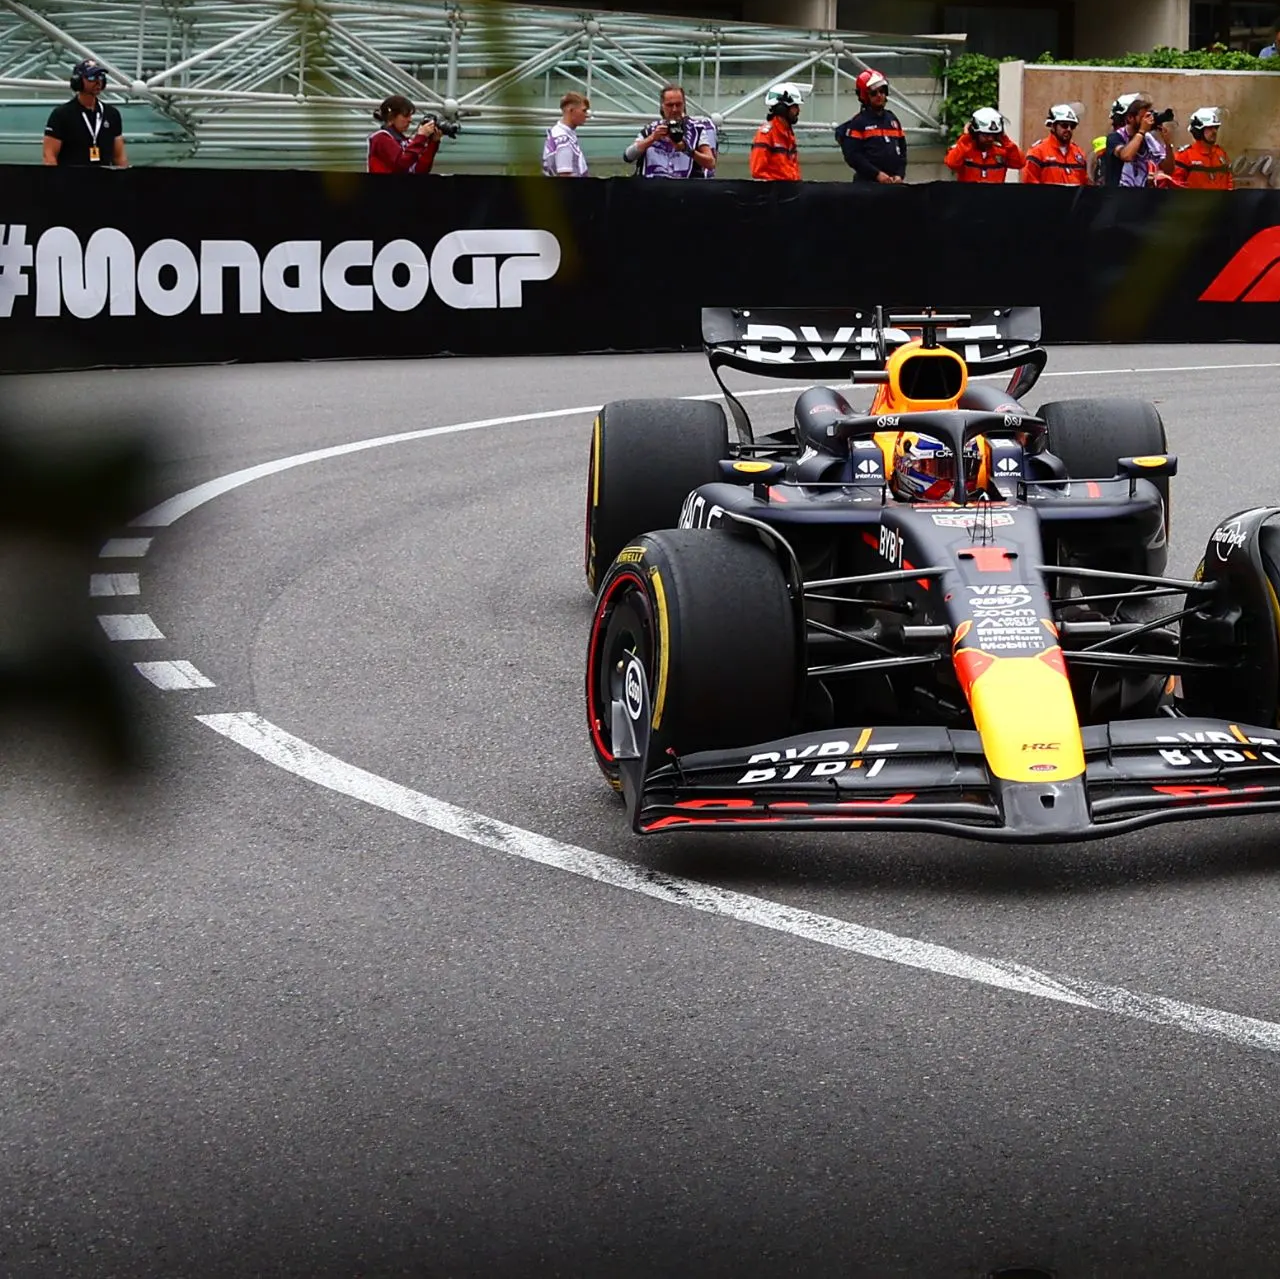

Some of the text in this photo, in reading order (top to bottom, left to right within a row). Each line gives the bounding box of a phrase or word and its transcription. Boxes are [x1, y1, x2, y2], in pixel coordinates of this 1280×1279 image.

[746, 324, 998, 363] BYBT
[966, 584, 1030, 595] VISA
[972, 609, 1037, 617] zoom
